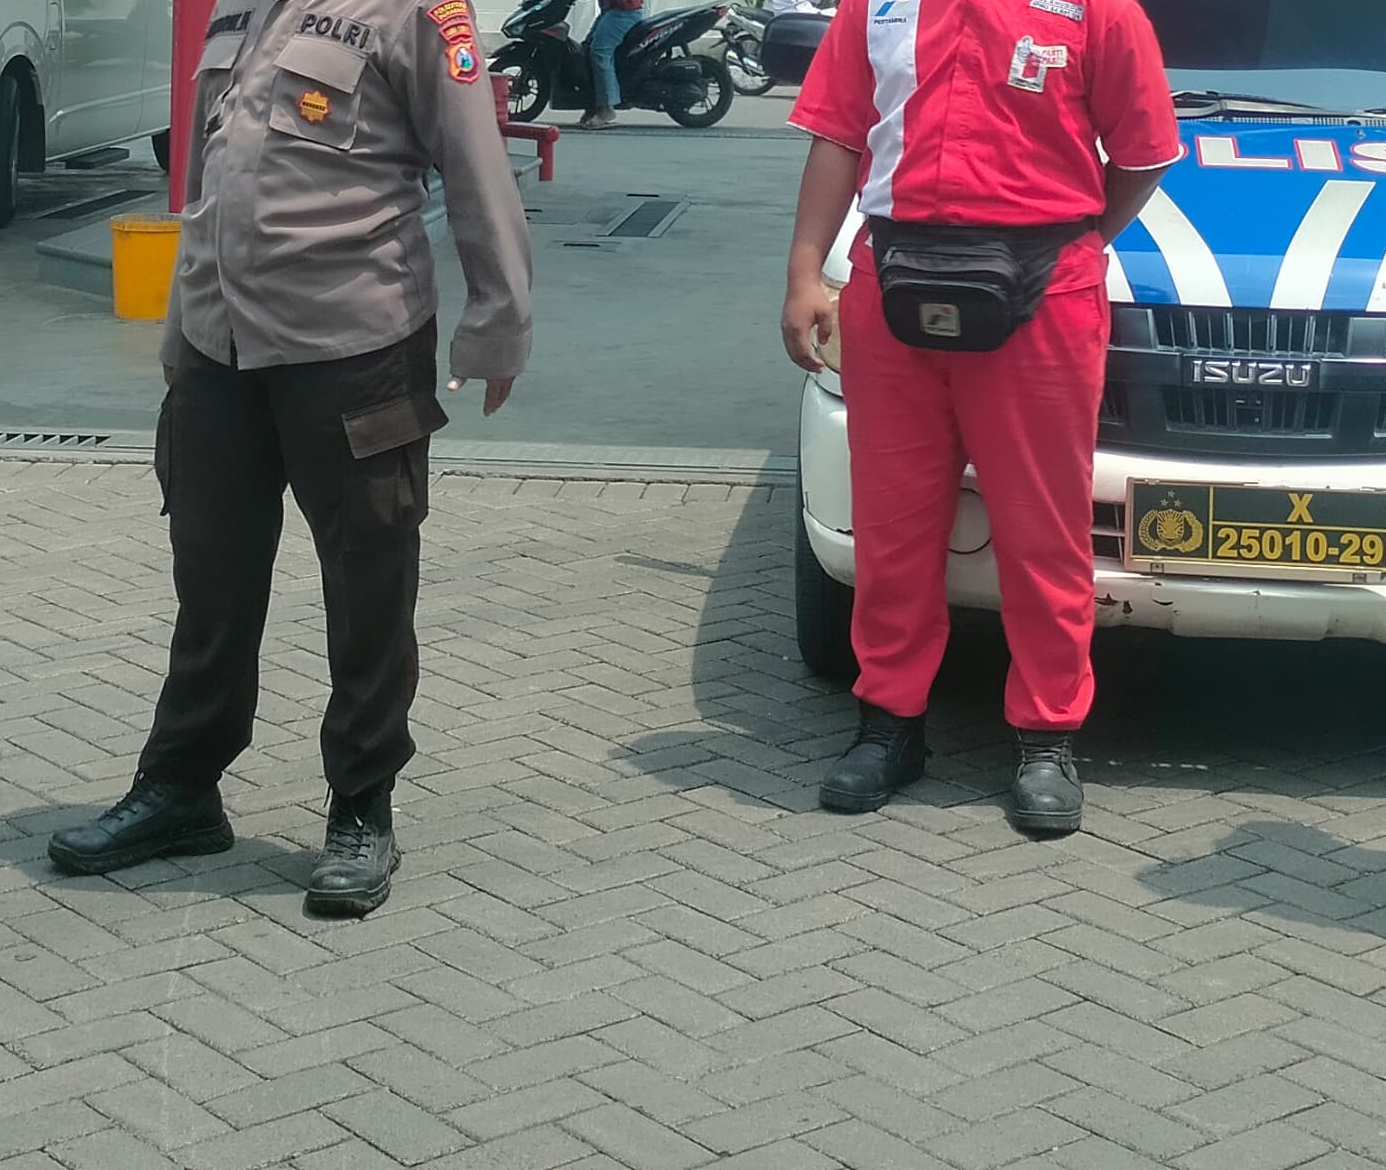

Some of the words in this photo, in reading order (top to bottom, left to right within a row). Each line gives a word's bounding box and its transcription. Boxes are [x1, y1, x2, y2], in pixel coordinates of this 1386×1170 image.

[300, 13, 370, 50] POLRI
[1192, 359, 1312, 388] ISUZU
[1287, 493, 1314, 523] X
[1216, 527, 1384, 566] 25010-29
